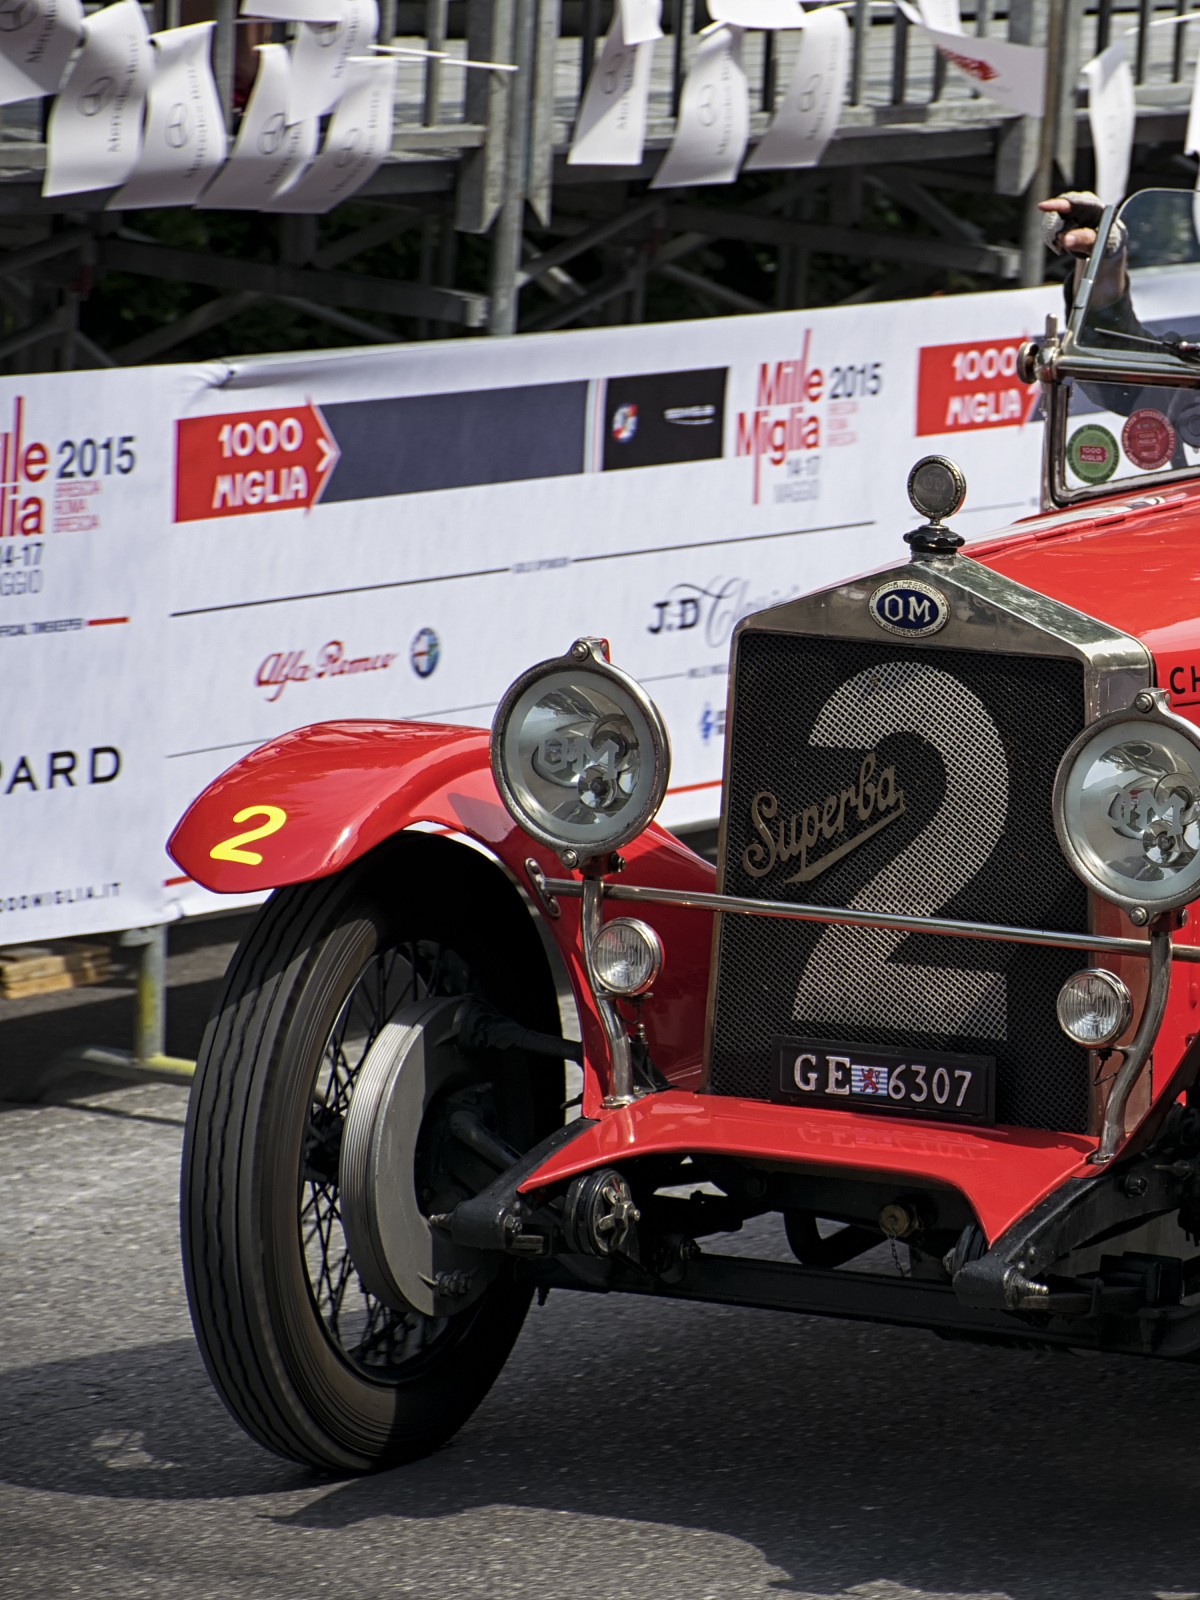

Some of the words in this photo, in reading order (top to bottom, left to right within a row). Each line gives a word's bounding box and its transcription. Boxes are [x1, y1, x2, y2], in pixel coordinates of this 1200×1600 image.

[757, 328, 825, 407] Mille
[828, 362, 884, 400] 2015
[951, 346, 1018, 382] 1000
[944, 388, 1023, 427] MIGLIA
[56, 435, 137, 479] 2015
[217, 417, 304, 459] 1000
[735, 406, 821, 505] Miglia
[211, 465, 309, 509] MIGLIA
[884, 594, 931, 623] OM
[255, 650, 312, 702] Alfa
[0, 746, 122, 795] ARD
[209, 805, 288, 866] 2
[742, 752, 906, 884] Superba
[790, 660, 1008, 1041] 2
[793, 1054, 850, 1096] GE
[888, 1064, 973, 1107] 6307
